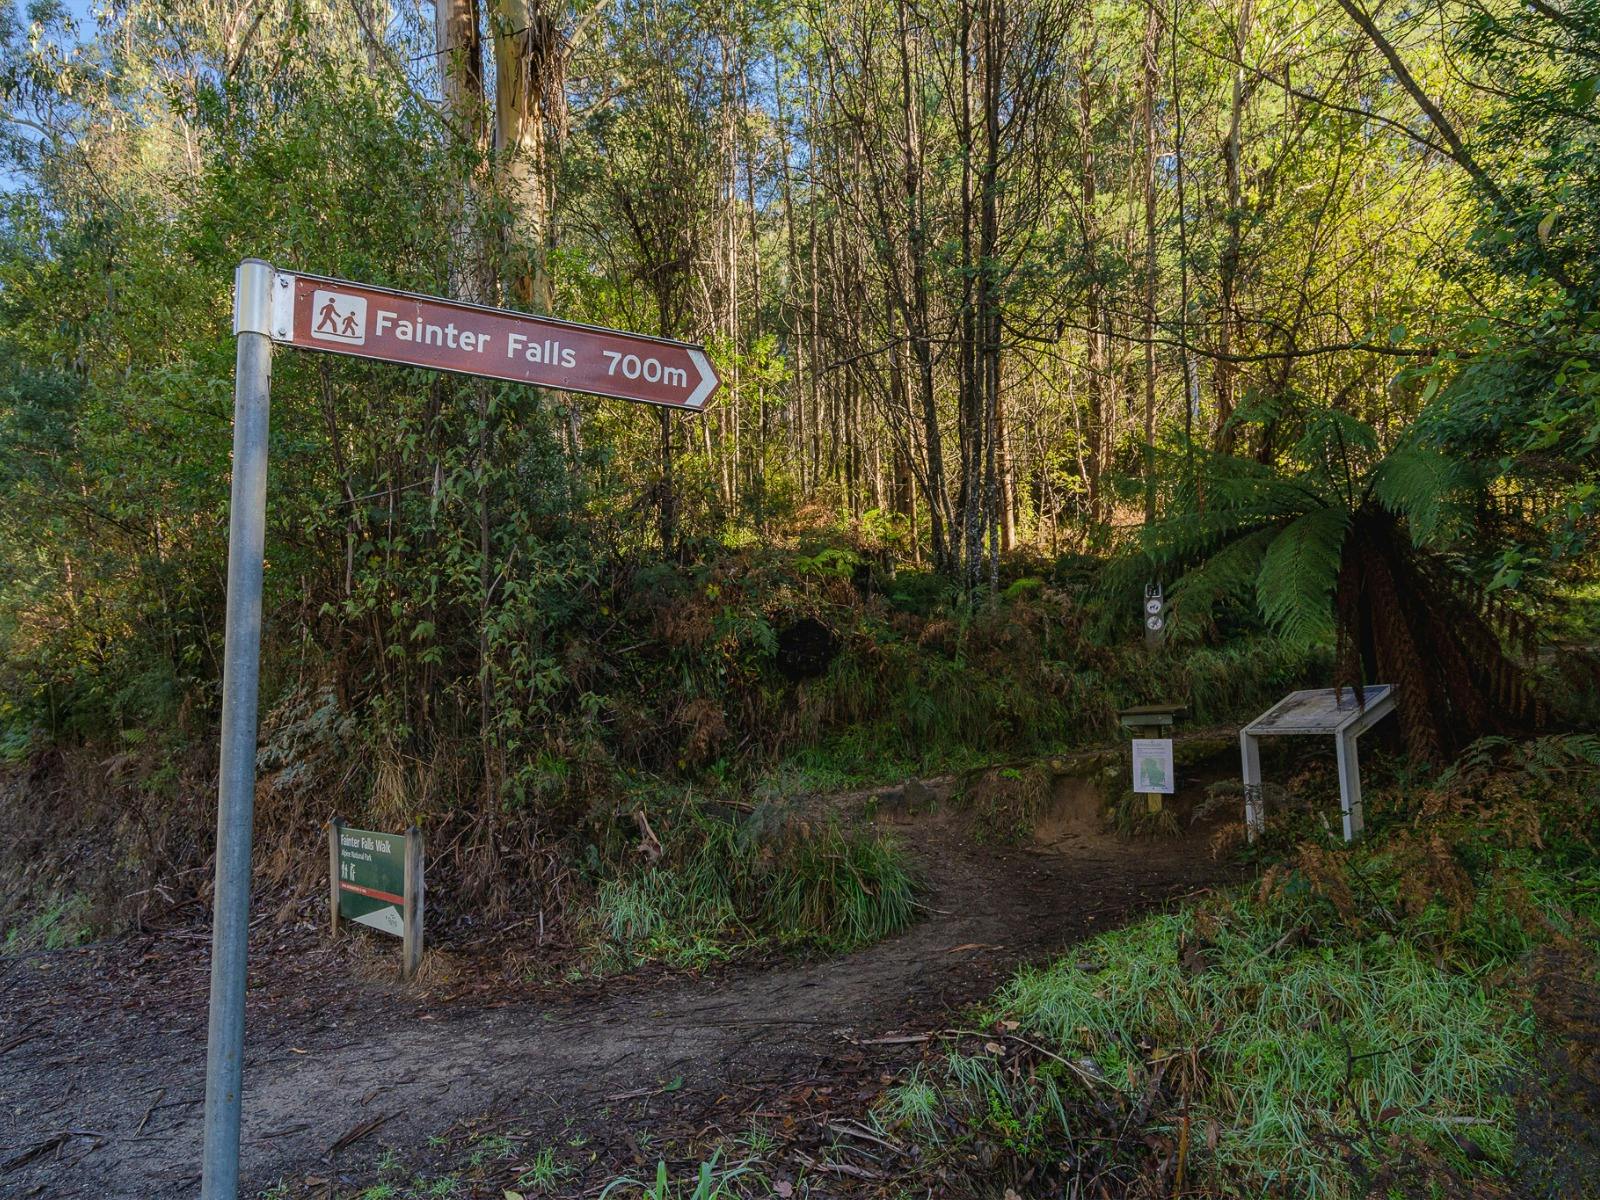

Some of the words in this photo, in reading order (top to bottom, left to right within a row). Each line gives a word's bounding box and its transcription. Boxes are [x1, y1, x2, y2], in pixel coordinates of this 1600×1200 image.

[375, 311, 491, 353] Fainter
[507, 332, 577, 369] Falls
[602, 350, 688, 388] 700m
[341, 834, 360, 848] Fainter
[361, 837, 374, 851] Falls
[375, 840, 391, 854] Walk
[352, 851, 364, 860] National
